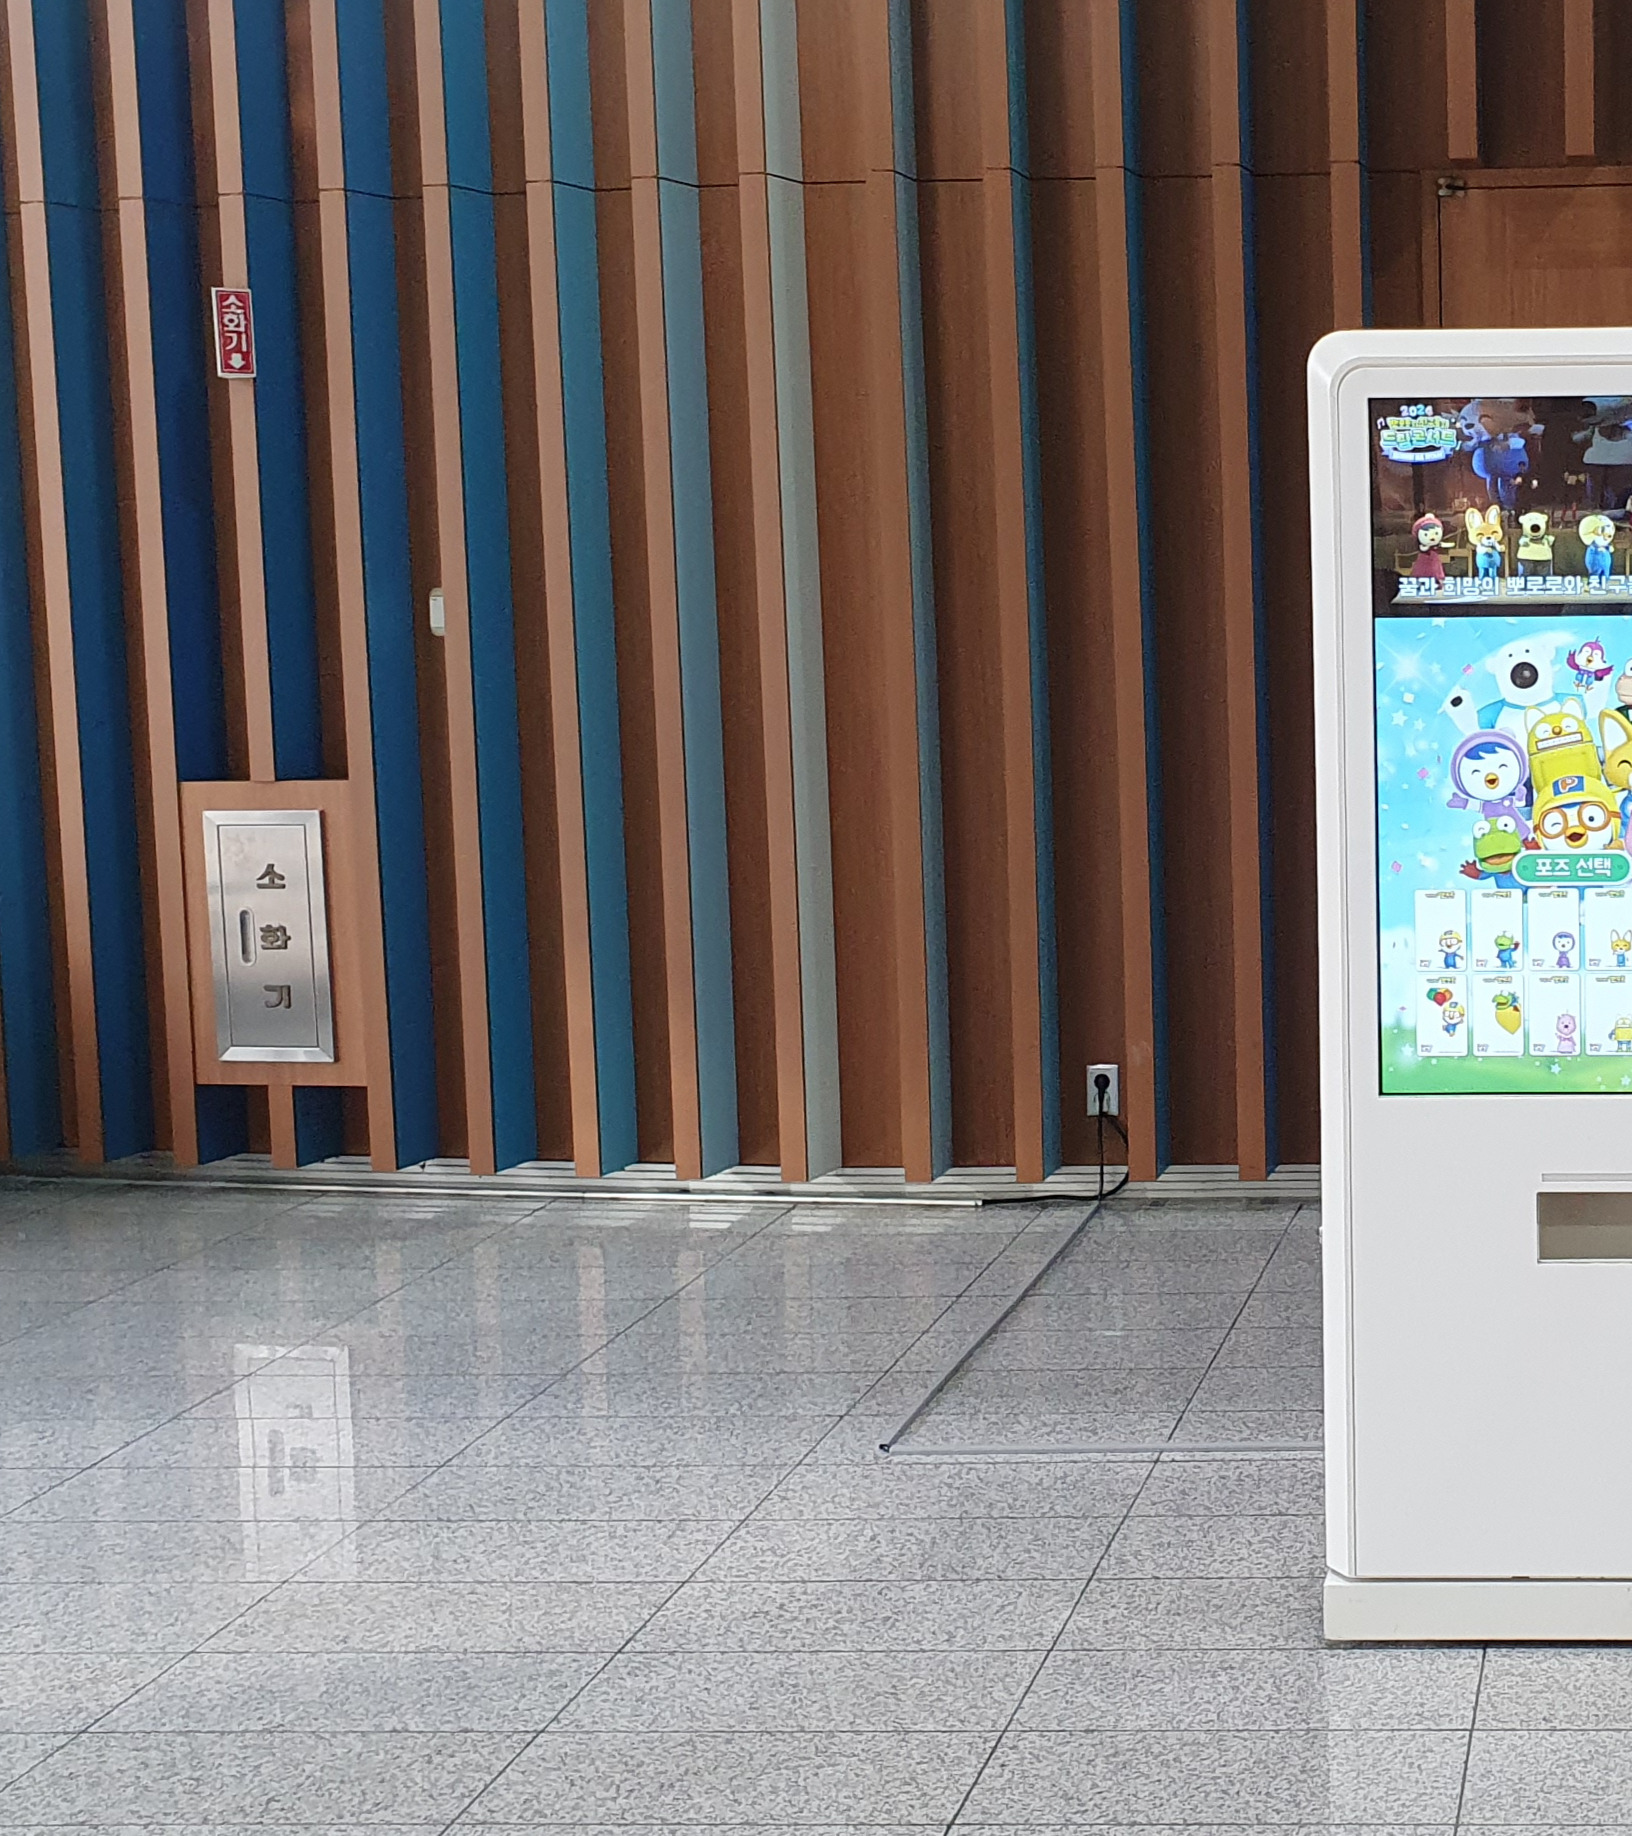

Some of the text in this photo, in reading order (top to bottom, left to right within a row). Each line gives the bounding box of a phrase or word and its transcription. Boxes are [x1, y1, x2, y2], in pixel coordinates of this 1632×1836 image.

[222, 295, 247, 352] 소화기
[1398, 577, 1438, 597] 꿈과
[1443, 576, 1499, 596] 희망의
[1506, 575, 1583, 596] 뽀로로와
[1535, 857, 1612, 878] 포즈 선택
